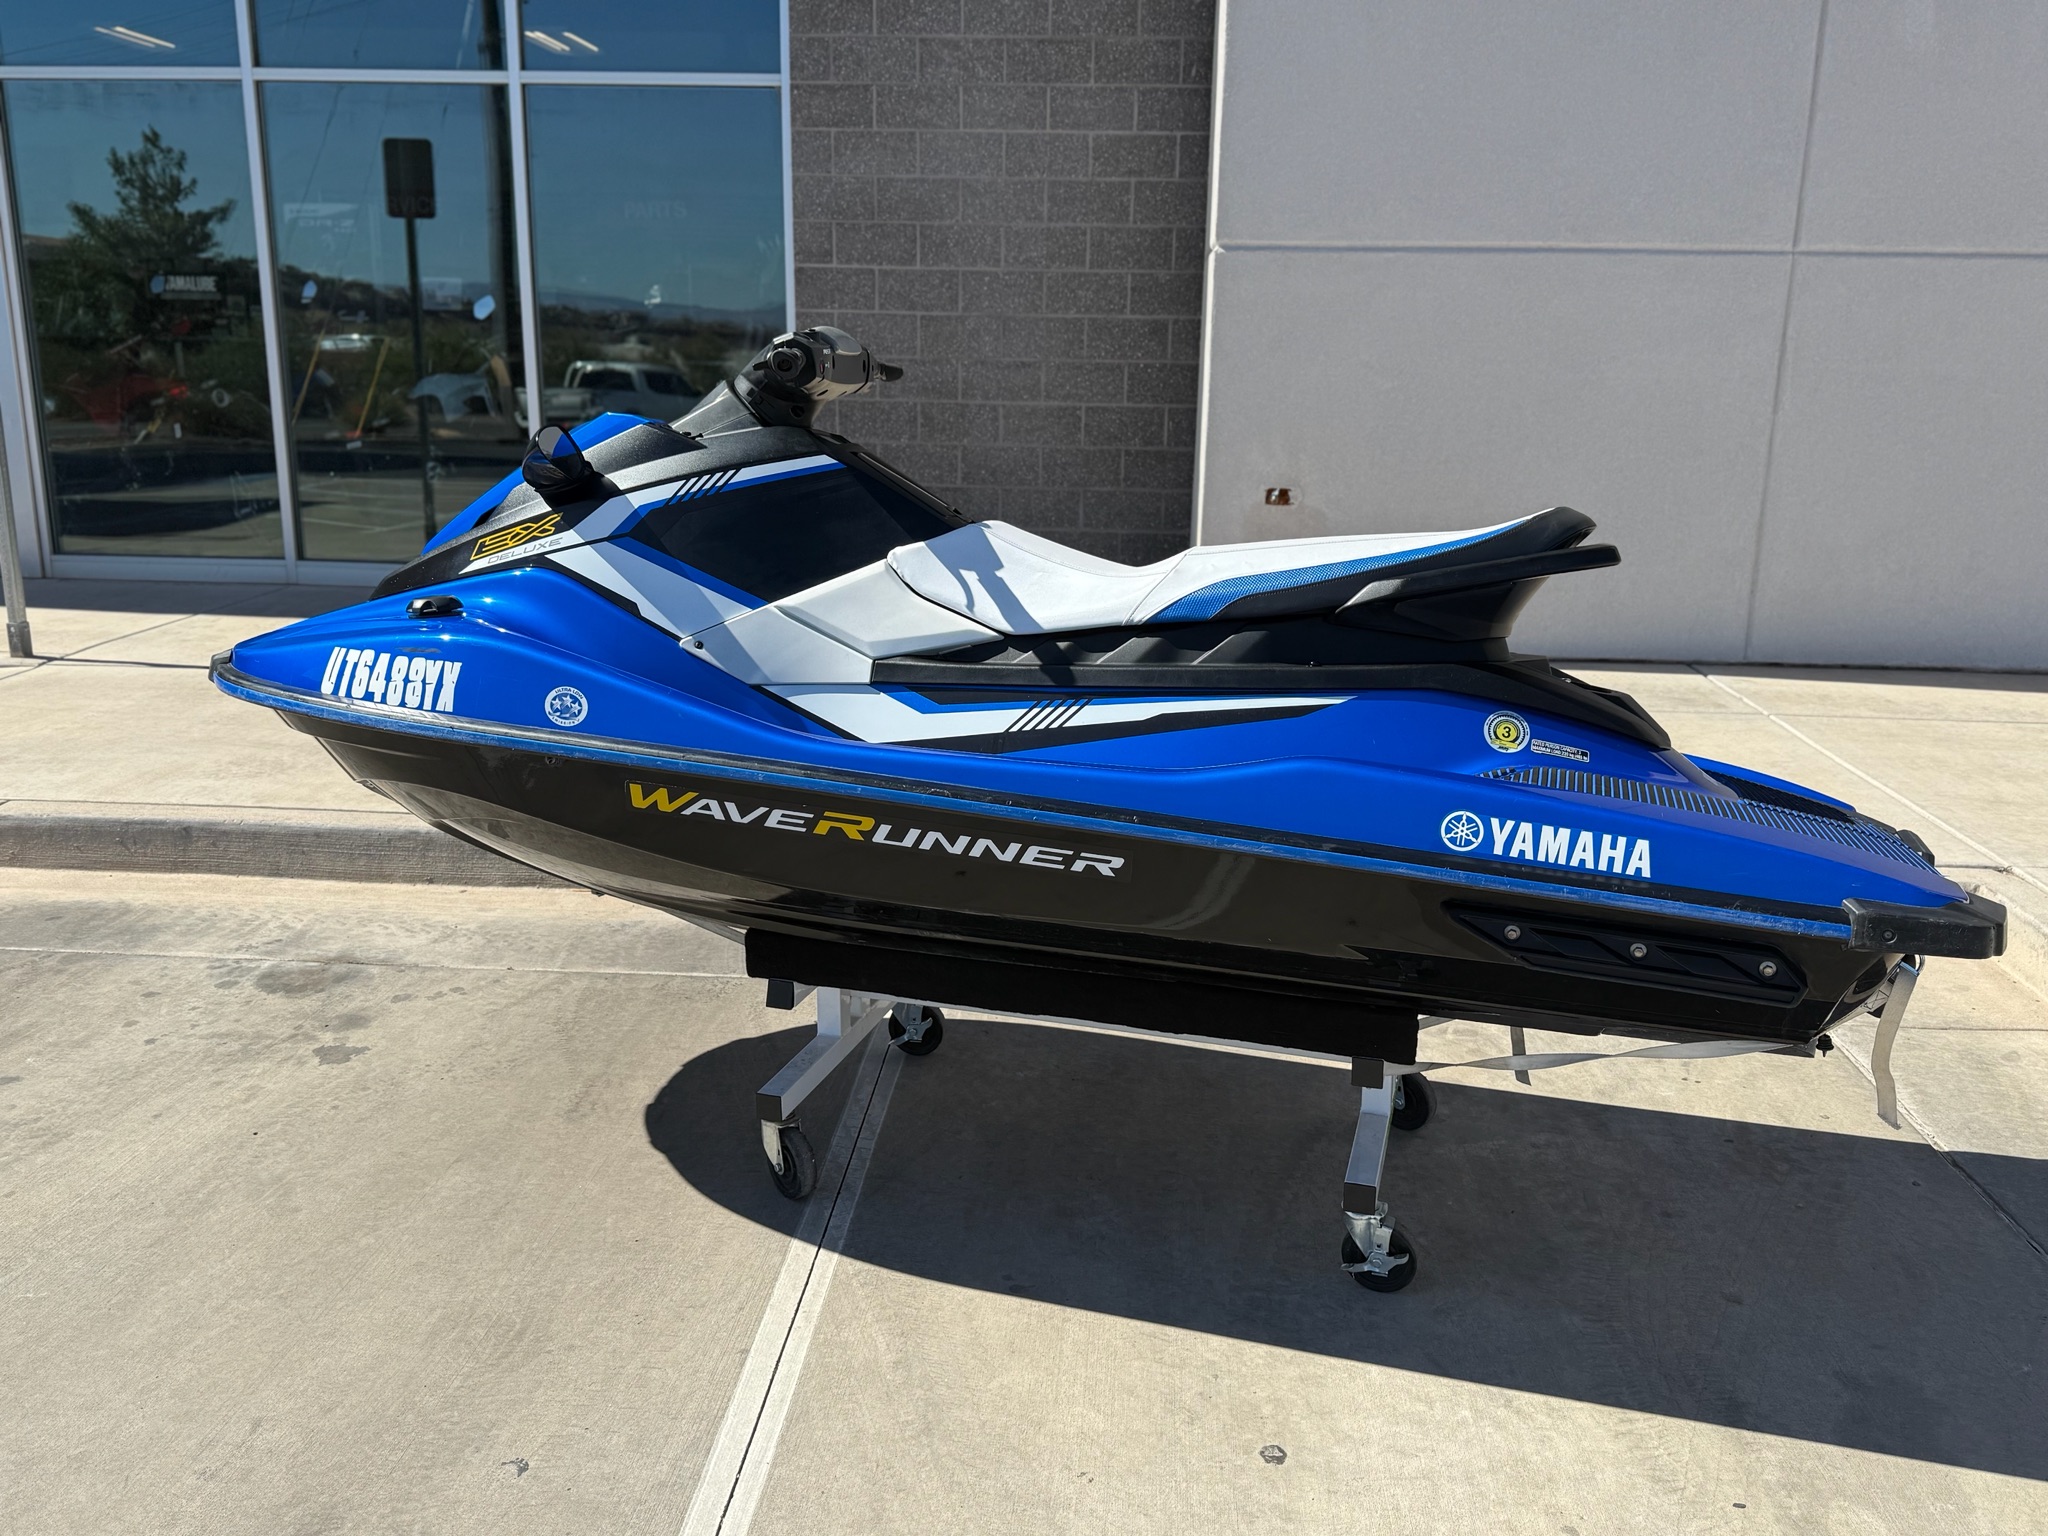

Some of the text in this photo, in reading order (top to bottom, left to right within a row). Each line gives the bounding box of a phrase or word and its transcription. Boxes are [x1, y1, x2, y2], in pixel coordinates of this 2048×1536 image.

[624, 199, 688, 219] PARTS
[469, 512, 564, 561] EX
[487, 536, 563, 564] DELUXE
[1501, 725, 1512, 739] 3
[1490, 817, 1651, 879] YAMAHA
